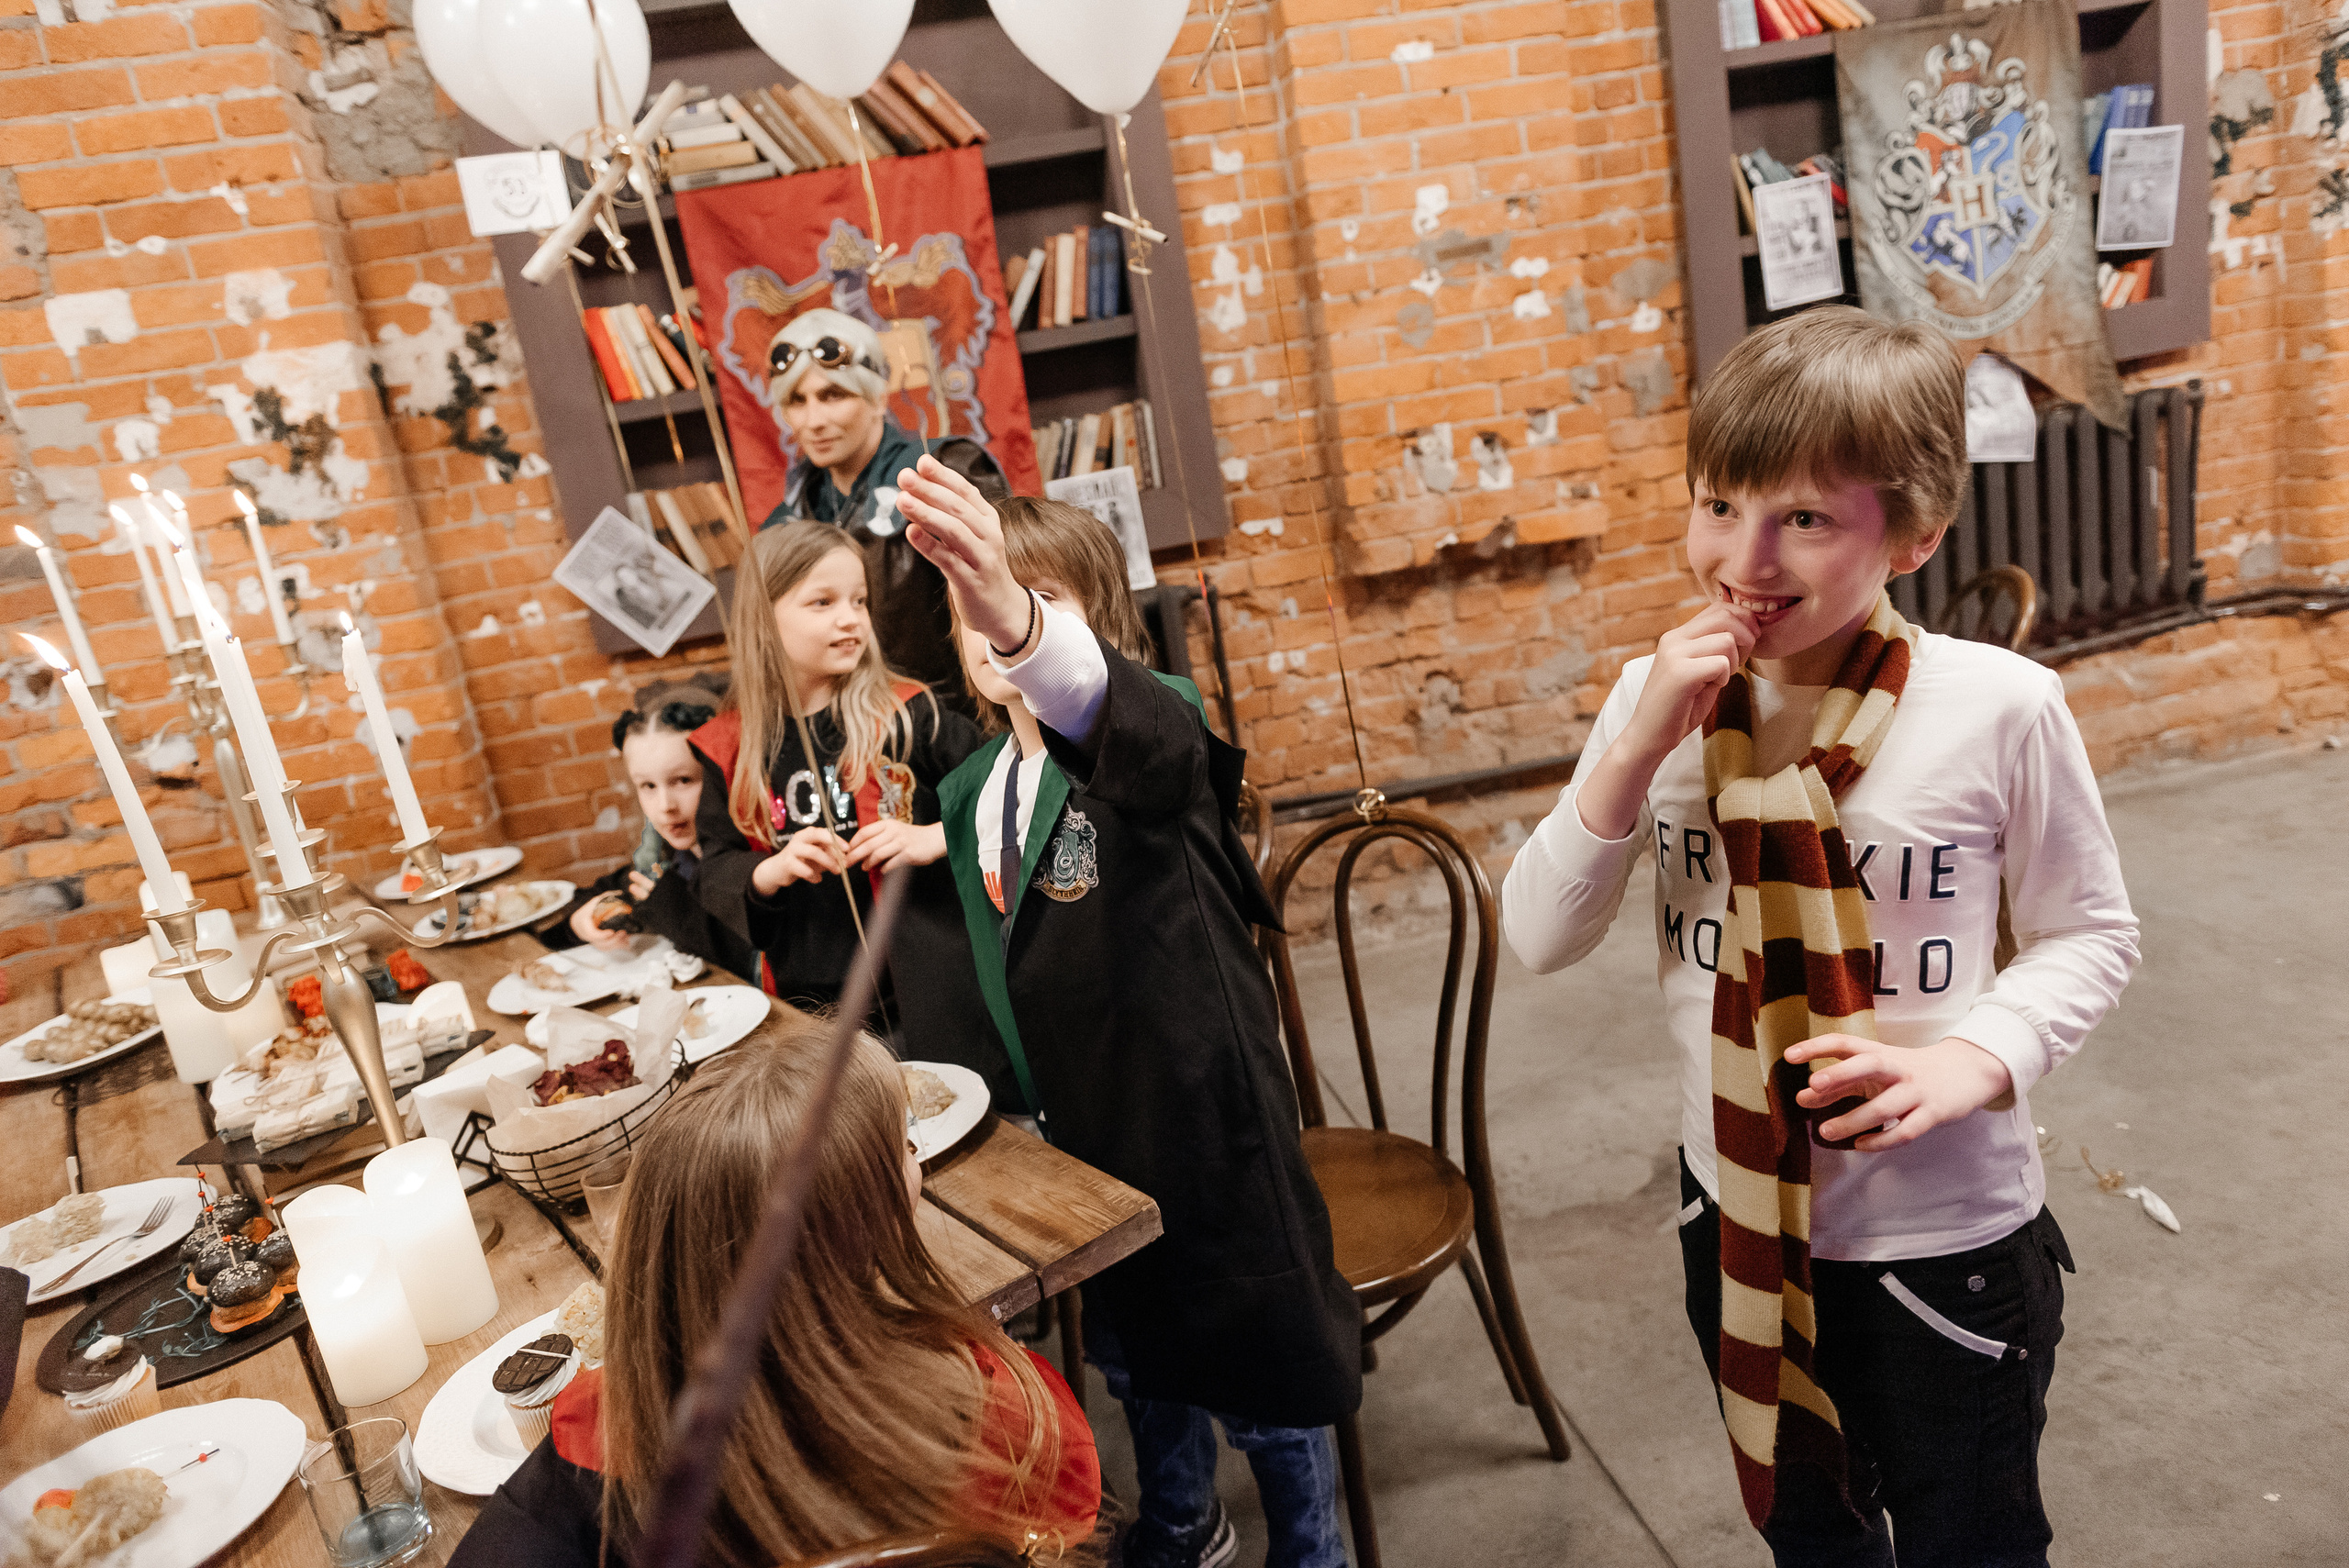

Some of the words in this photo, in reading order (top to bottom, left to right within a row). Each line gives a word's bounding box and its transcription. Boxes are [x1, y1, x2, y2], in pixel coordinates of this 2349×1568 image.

[1961, 184, 1987, 222] H
[1657, 820, 1958, 901] FRKIE
[1048, 885, 1084, 897] SLYTHERIN
[1664, 904, 1953, 995] MOLO
